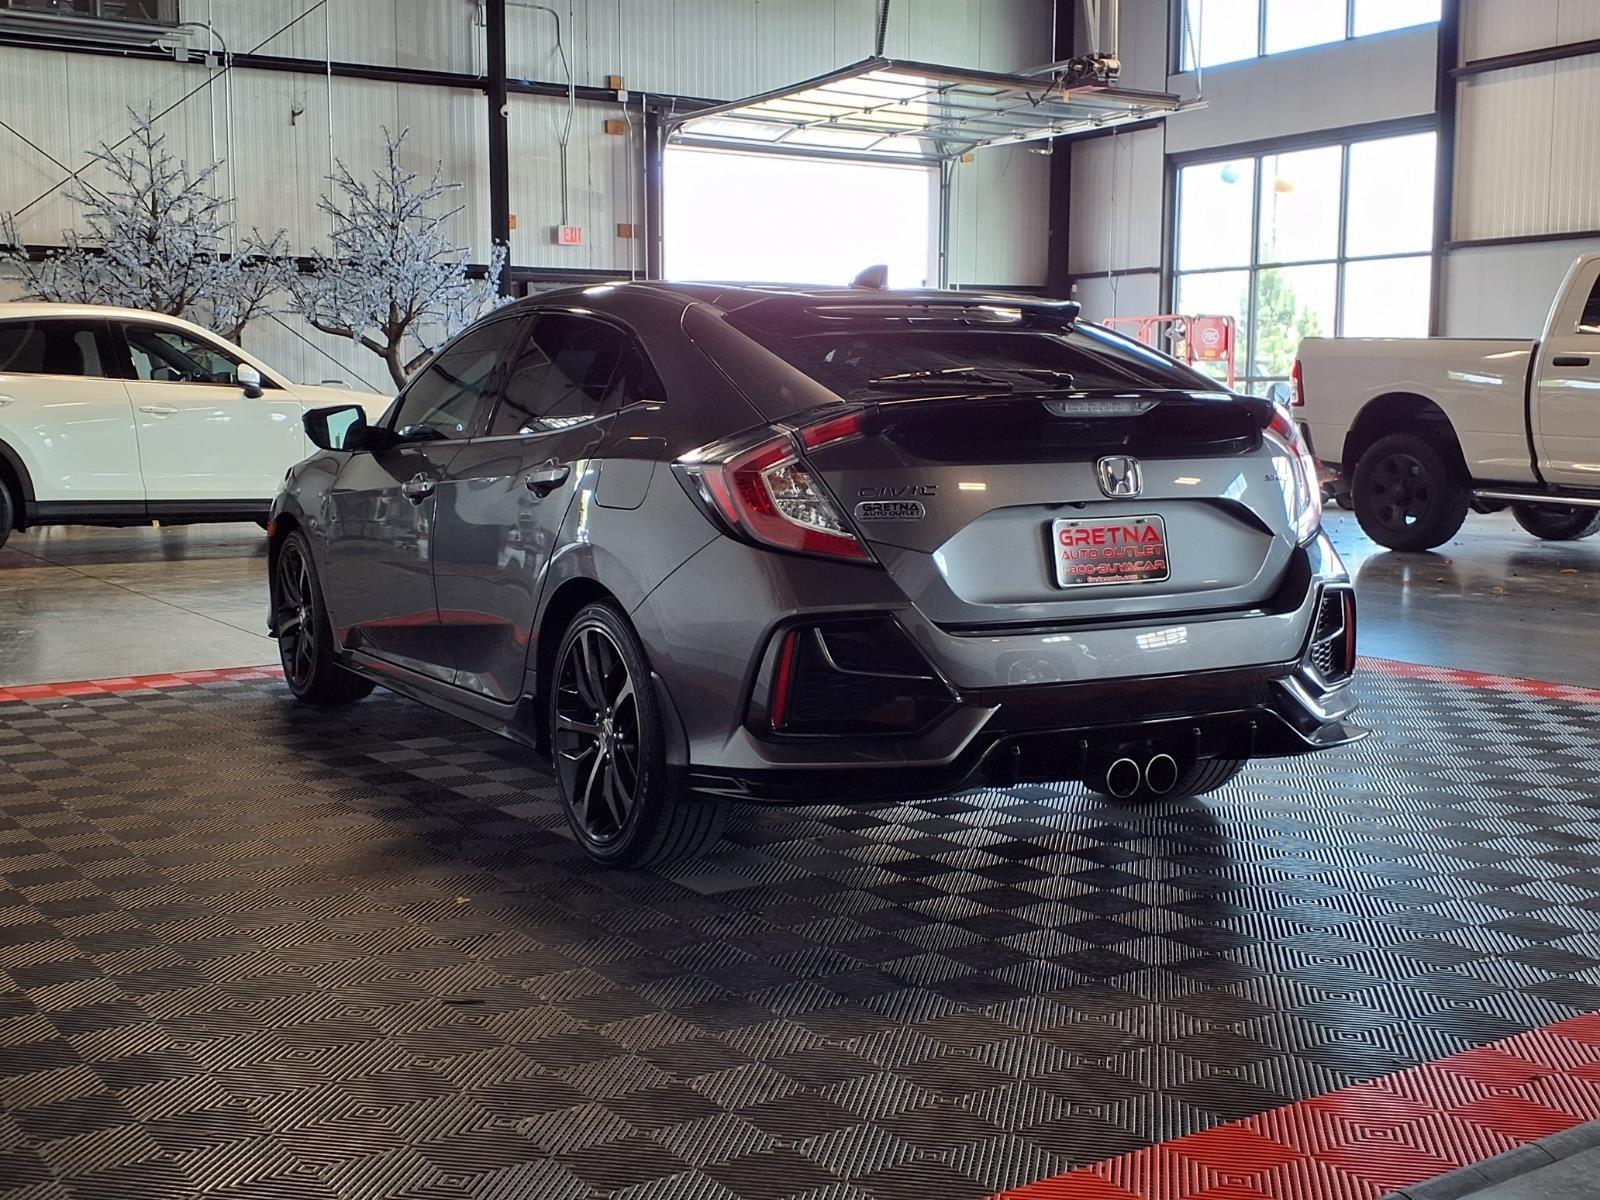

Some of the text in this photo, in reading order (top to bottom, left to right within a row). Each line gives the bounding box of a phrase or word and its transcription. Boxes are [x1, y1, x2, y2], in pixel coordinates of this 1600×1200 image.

[563, 226, 582, 243] EXIT
[857, 485, 939, 498] CIVIC
[862, 502, 920, 512] GRETNA
[1060, 525, 1160, 547] GRETNA
[1061, 544, 1163, 560] AUTO OUTLET
